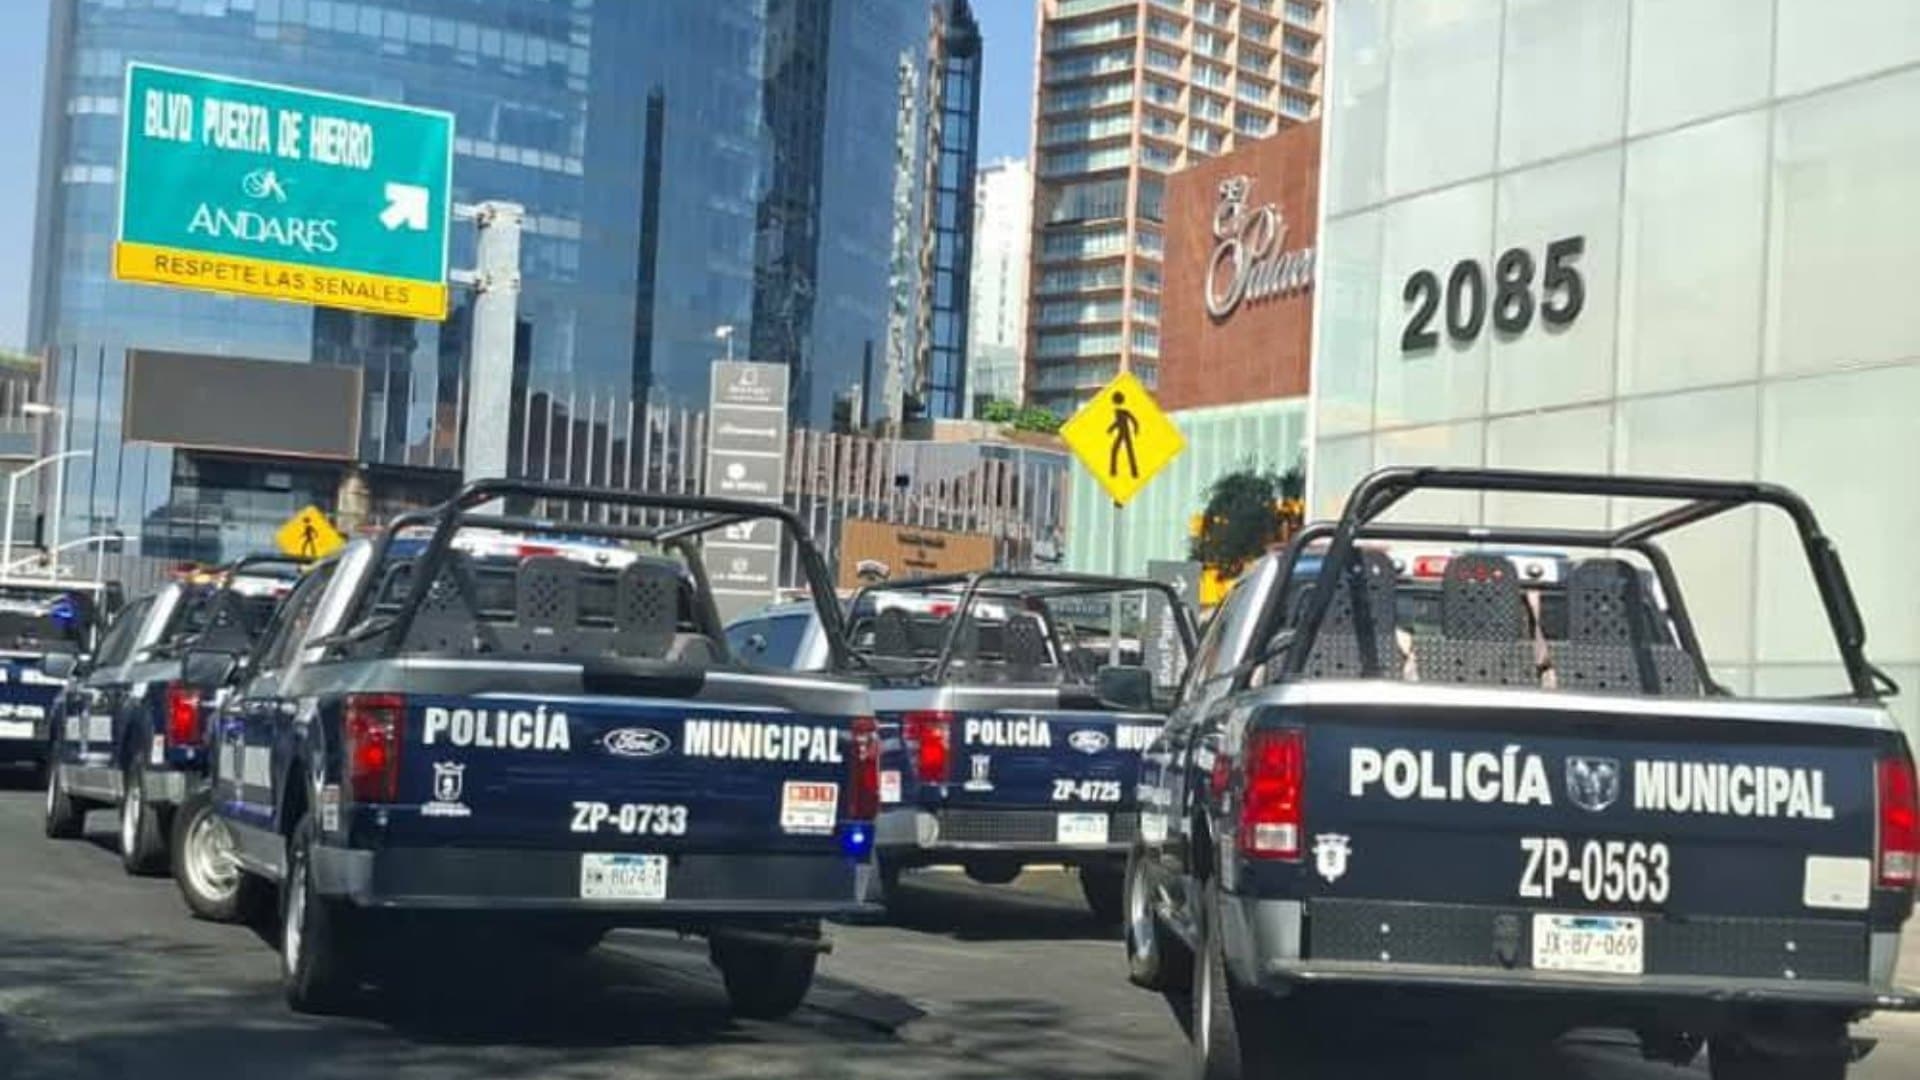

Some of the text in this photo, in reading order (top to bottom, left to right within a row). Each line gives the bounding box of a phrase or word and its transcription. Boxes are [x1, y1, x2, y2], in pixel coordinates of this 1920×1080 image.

[145, 89, 373, 170] BLVD PUERTA DE HIERRO
[187, 202, 339, 254] ANDARES
[154, 254, 259, 283] RESPETE
[263, 267, 305, 291] LAS
[1401, 236, 1586, 352] 2085
[423, 704, 571, 750] POLICÍA
[683, 719, 844, 763] MUNICIPAL
[965, 717, 1052, 748] POLICÍA
[1350, 744, 1834, 820] POLICÍA MUNICIPAL
[570, 801, 688, 835] ZP-0733
[1519, 837, 1670, 903] ZP-0563
